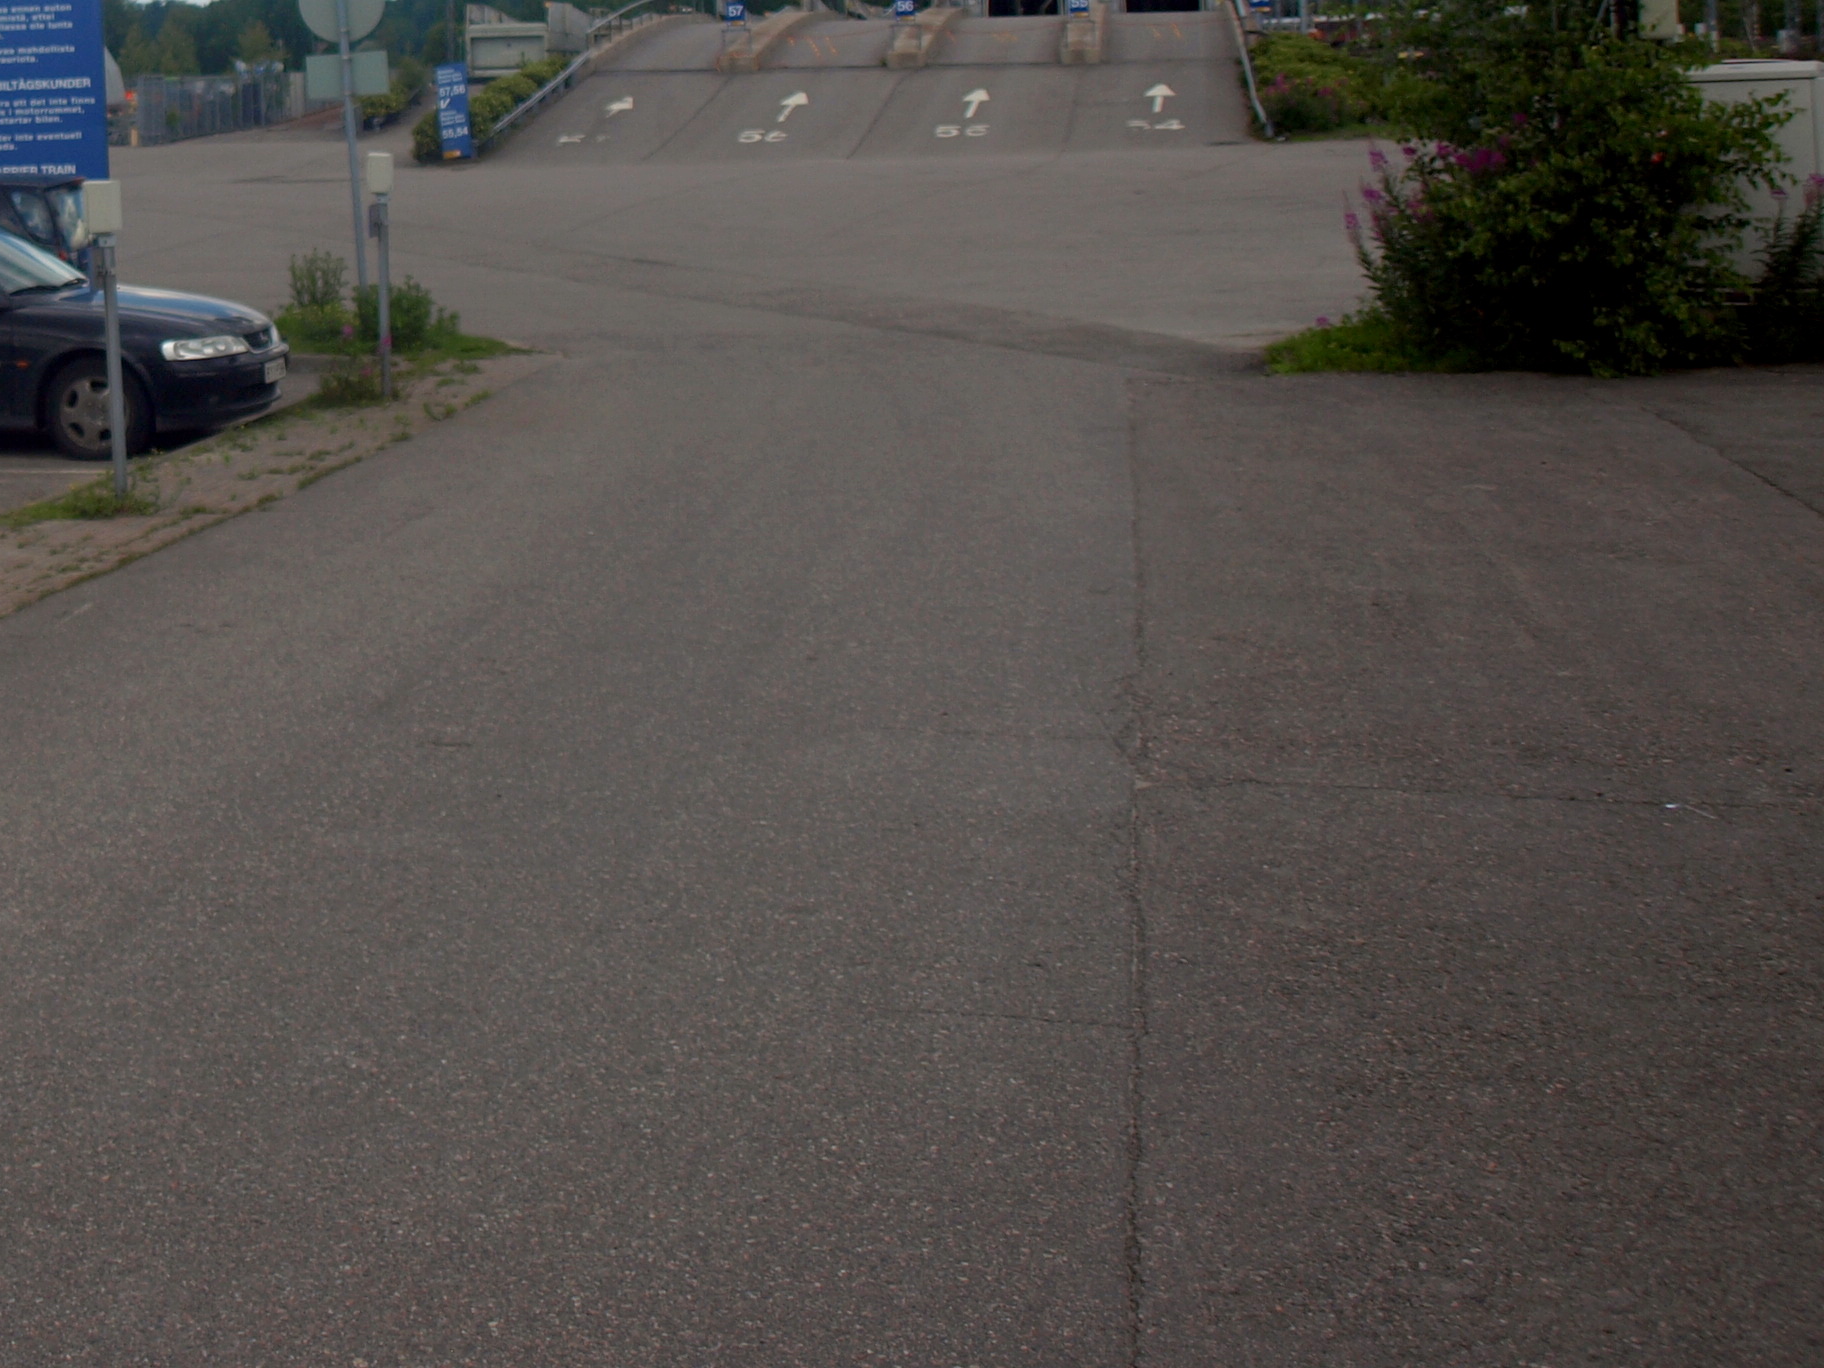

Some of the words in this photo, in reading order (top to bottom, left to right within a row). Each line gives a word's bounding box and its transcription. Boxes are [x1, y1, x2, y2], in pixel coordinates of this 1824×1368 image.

[728, 5, 744, 17] 57
[897, 0, 914, 12] 56
[41, 164, 76, 175] TRAIN
